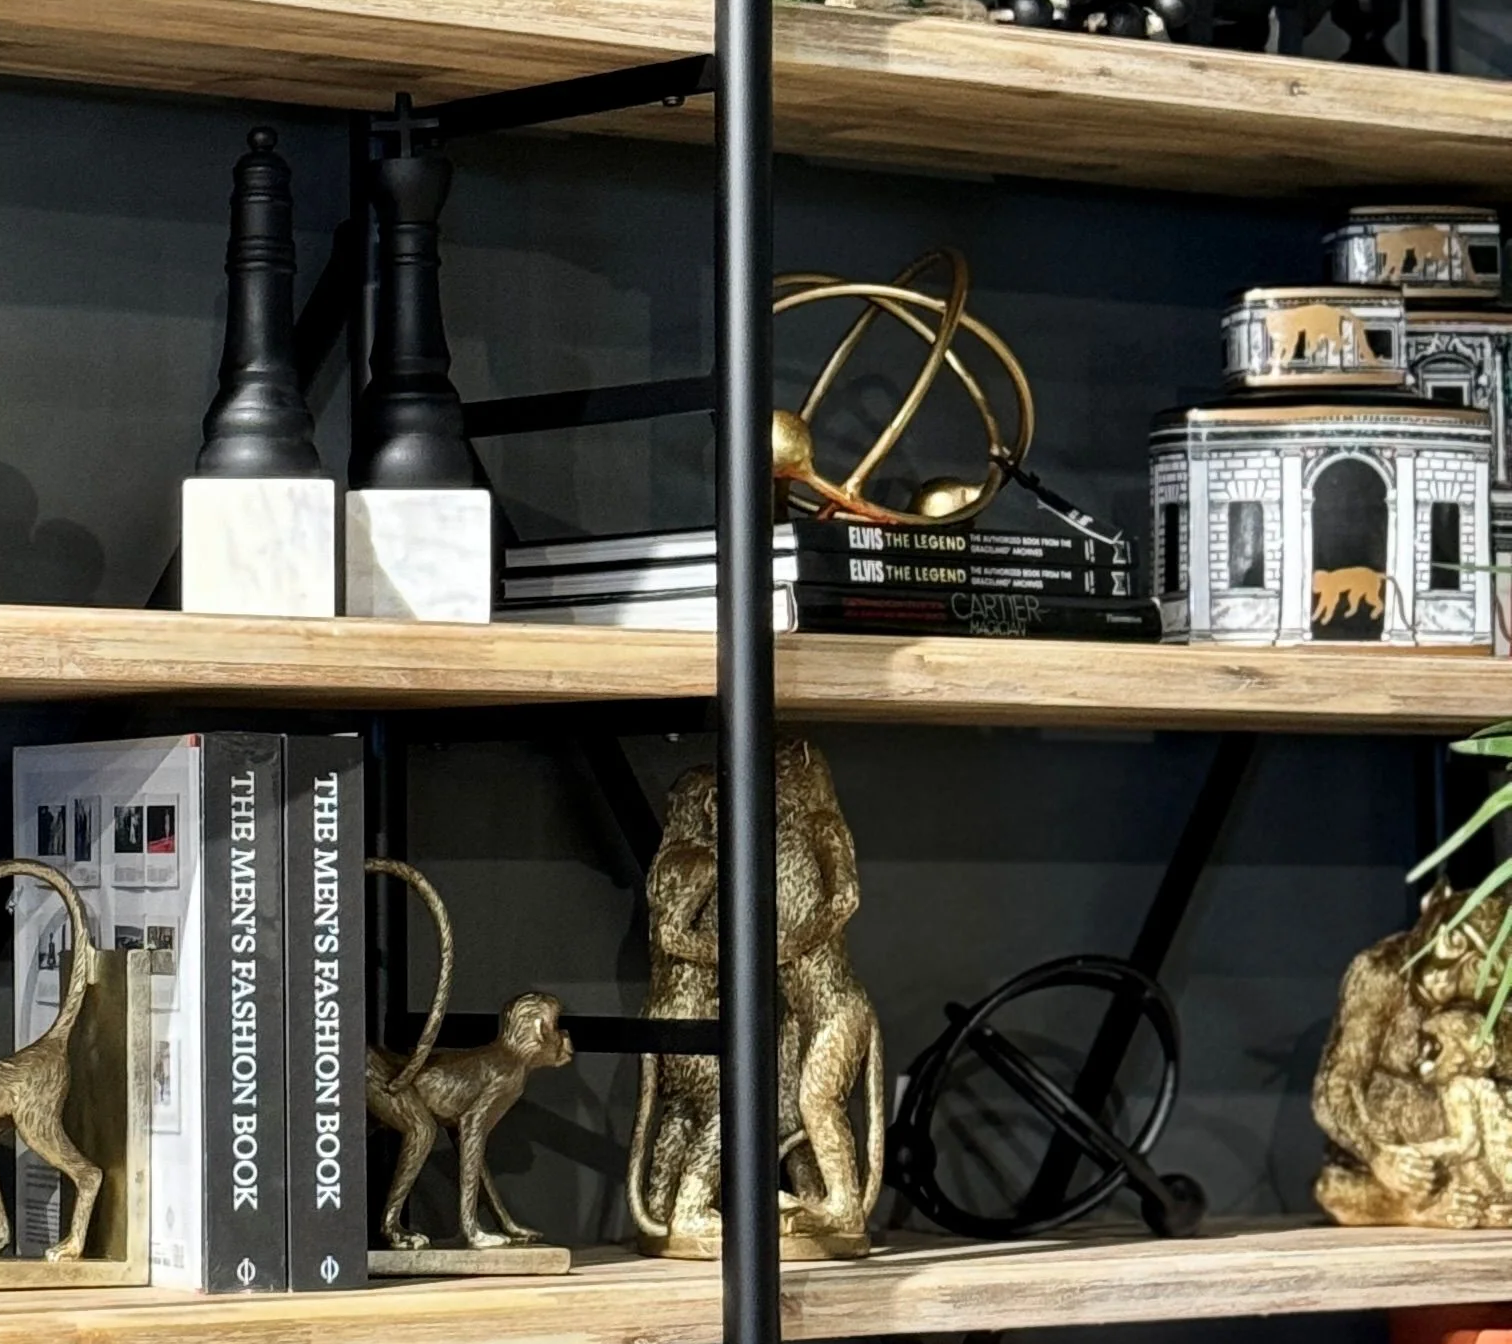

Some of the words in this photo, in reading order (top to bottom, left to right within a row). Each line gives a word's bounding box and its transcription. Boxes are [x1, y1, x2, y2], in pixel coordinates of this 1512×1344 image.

[848, 526, 884, 550] ELVIS
[884, 532, 910, 548] THE
[913, 533, 966, 551] LEGEND
[849, 558, 885, 583] ELVIS
[885, 565, 911, 581] THE
[914, 567, 967, 583] LEGEND
[951, 592, 1041, 622] CARTIER
[230, 770, 256, 842] THE
[313, 771, 338, 843] THE
[230, 847, 257, 953] MEN'S
[313, 847, 340, 953] MEN'S
[231, 959, 257, 1108] FASHION
[314, 959, 340, 1106] FASHION
[232, 1113, 258, 1211] BOOK
[315, 1112, 341, 1210] BOOK
